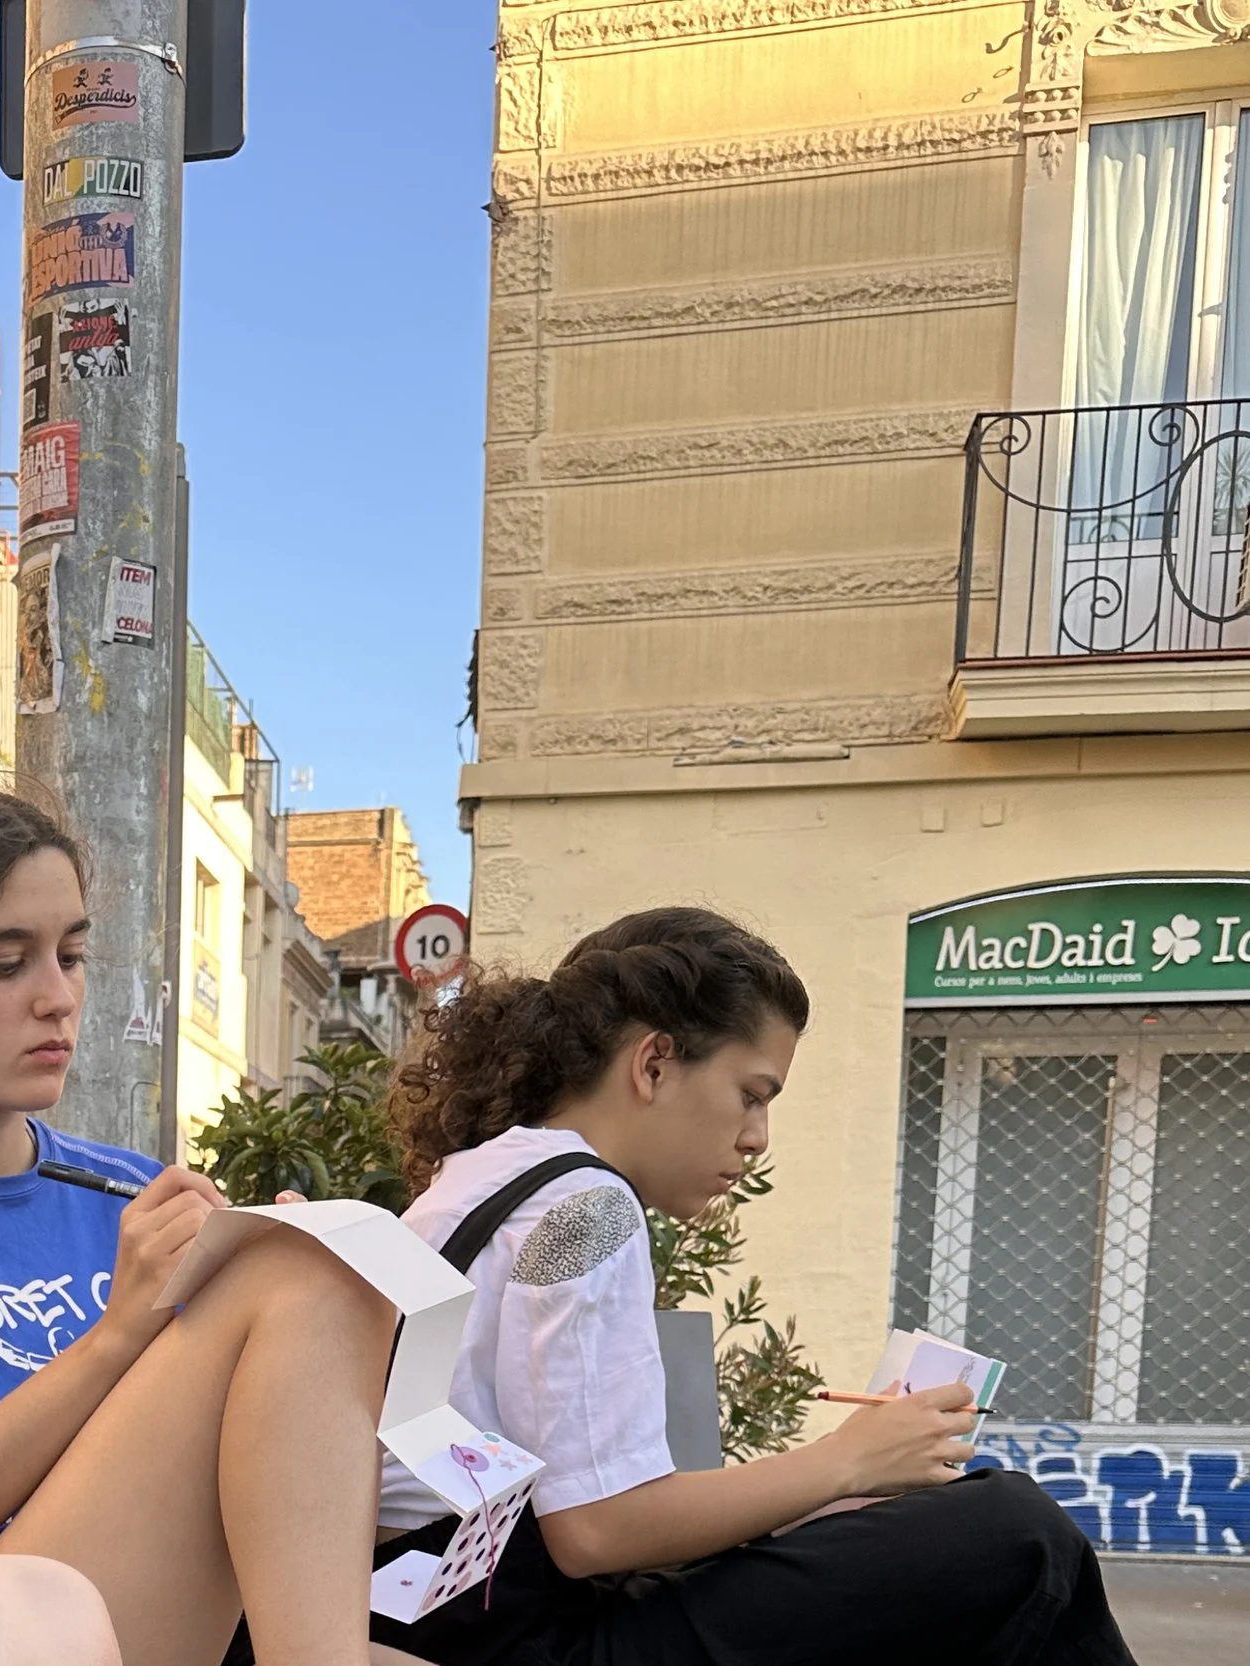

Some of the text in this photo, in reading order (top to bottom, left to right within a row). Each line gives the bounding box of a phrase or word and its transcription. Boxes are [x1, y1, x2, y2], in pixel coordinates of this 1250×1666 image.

[54, 88, 132, 112] Desperdicis
[44, 159, 141, 203] DAL POZZO
[416, 934, 450, 960] 10
[935, 919, 1136, 972] MacDaid
